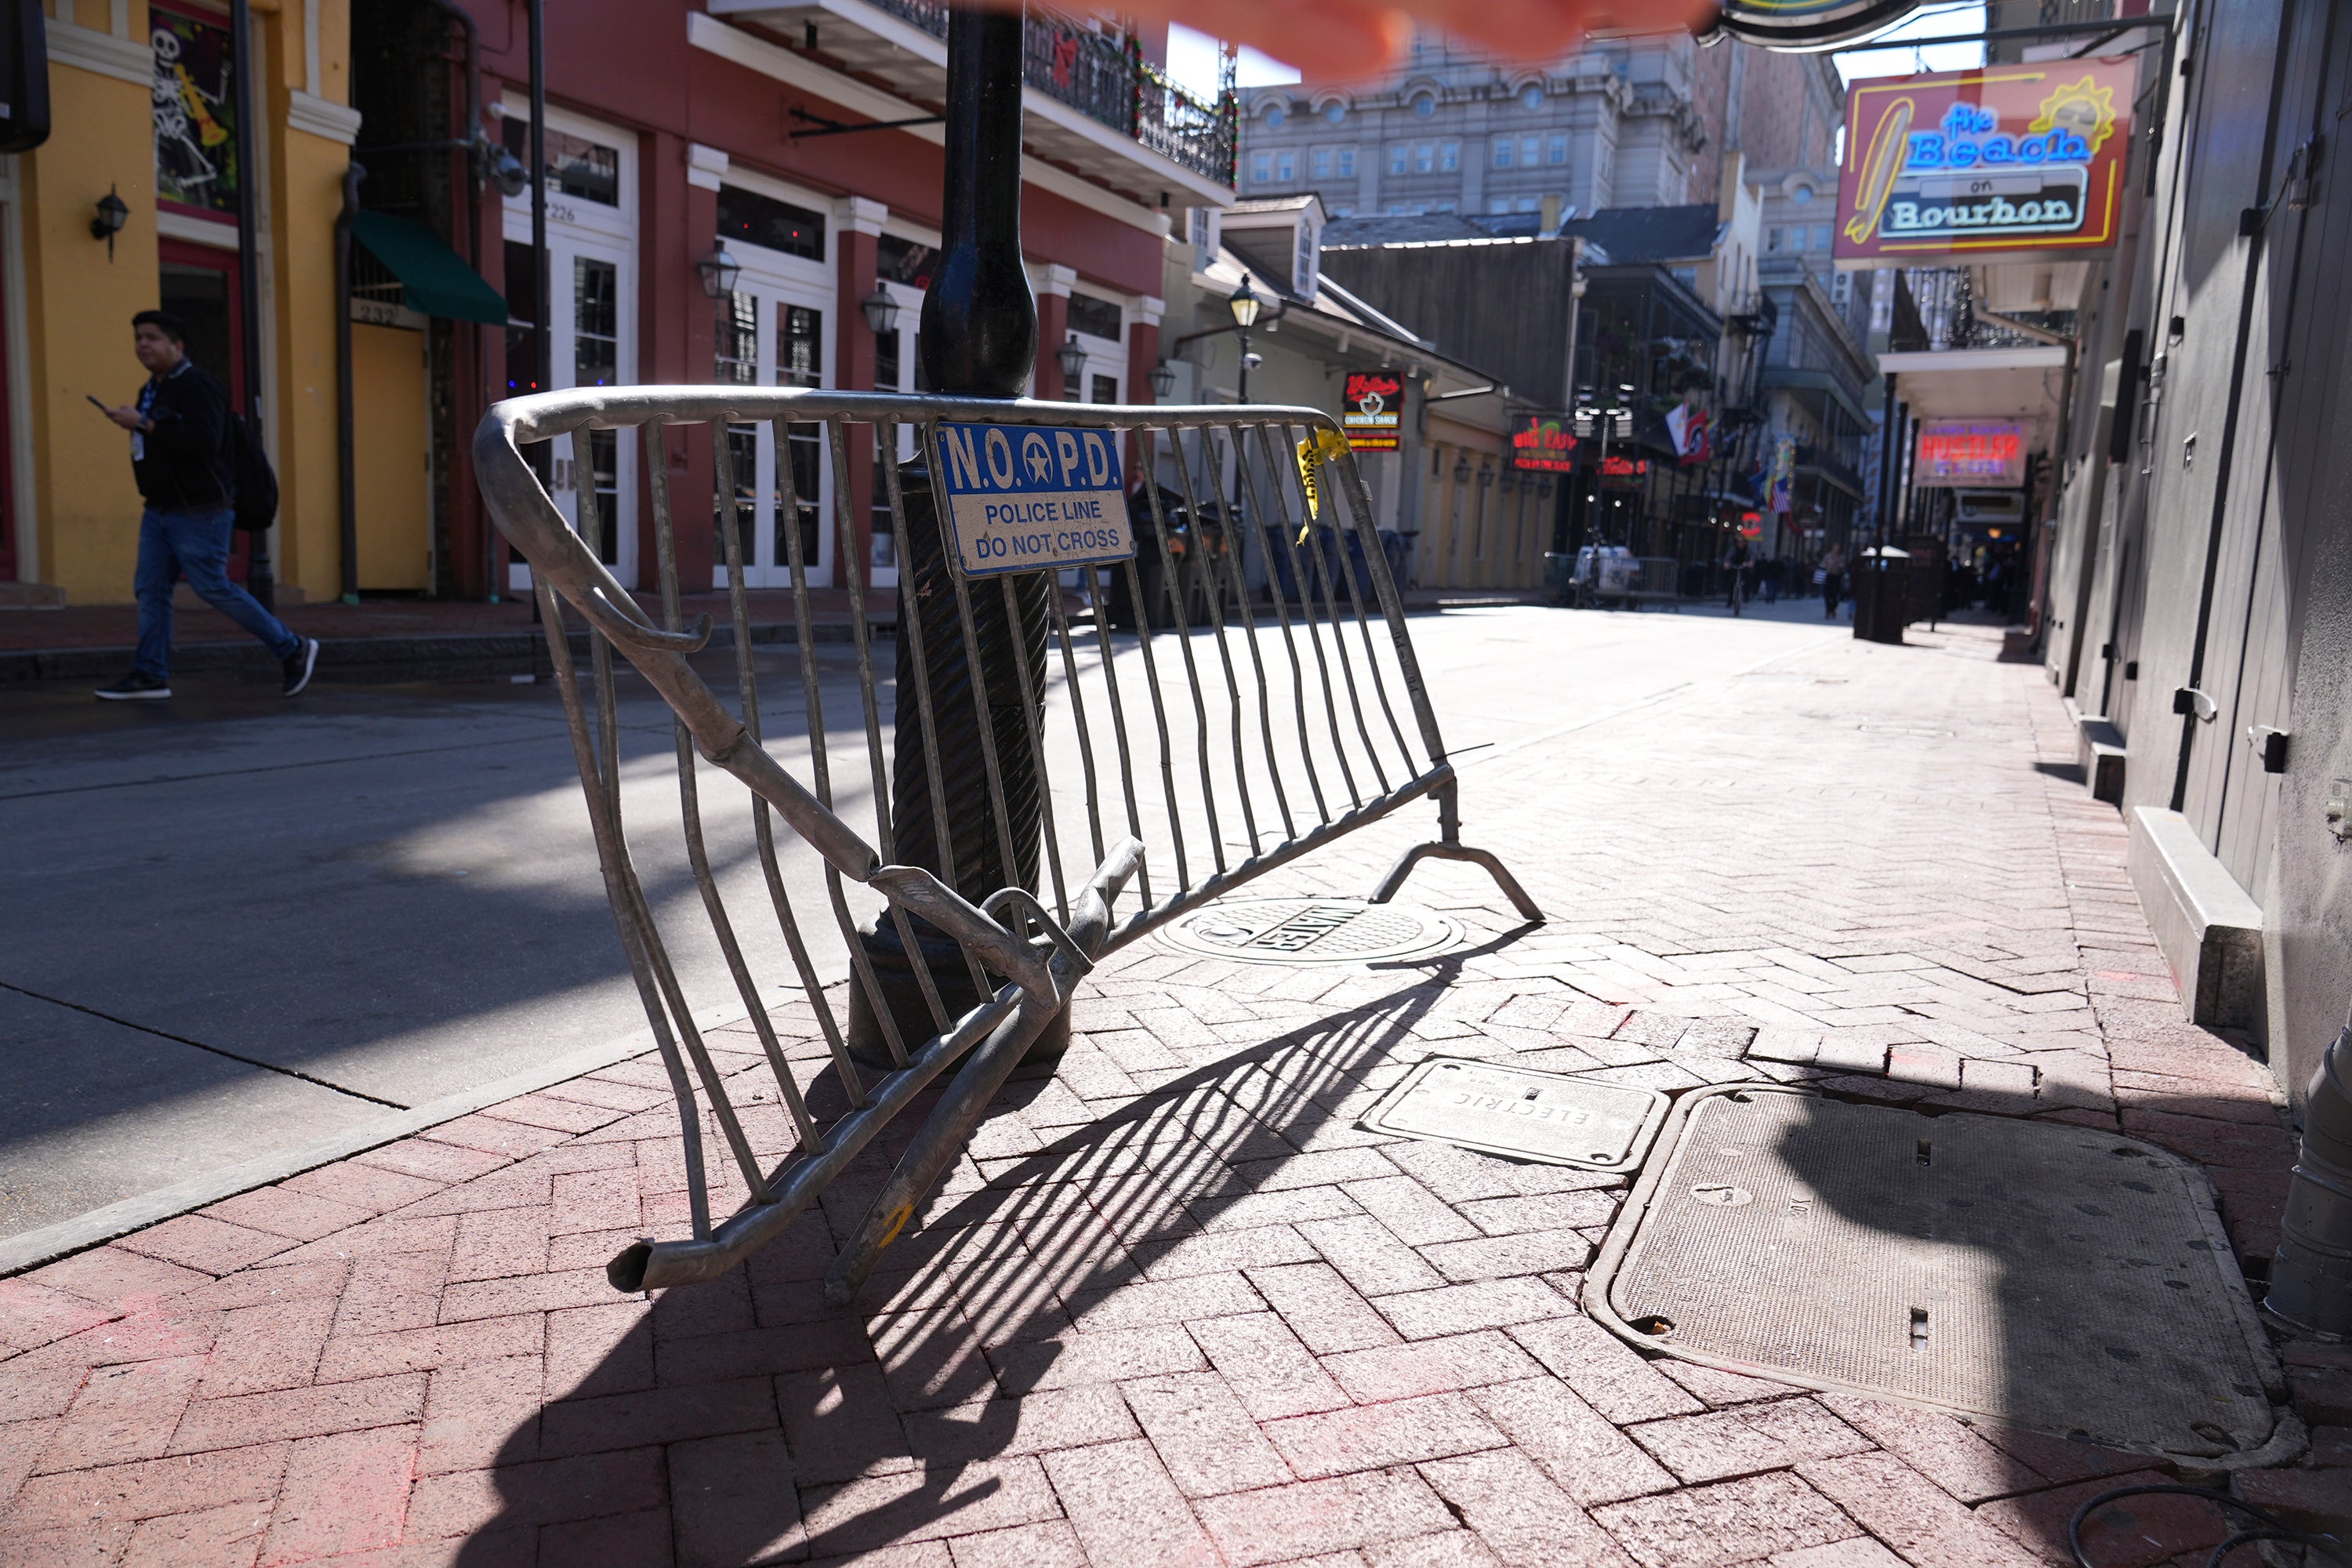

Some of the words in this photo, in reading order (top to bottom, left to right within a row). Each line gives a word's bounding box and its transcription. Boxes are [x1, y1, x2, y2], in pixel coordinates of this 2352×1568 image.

[1944, 103, 1994, 139] the
[1907, 127, 2092, 167] Beach
[1970, 180, 1992, 194] on
[551, 204, 575, 223] 226
[1891, 197, 2074, 230] Bourbon
[1513, 429, 1539, 448] BIG
[1544, 429, 1578, 451] EASY
[1922, 435, 2020, 460] HUSTLER
[1936, 459, 2004, 475] CLUB
[985, 502, 1058, 525] POLICE
[1062, 500, 1102, 521] LINE
[975, 537, 1007, 559] DO
[1012, 533, 1052, 556] NOT
[1058, 528, 1120, 552] CROSS
[1254, 905, 1367, 952] WATER
[1454, 1092, 1591, 1126] ELECTRIC
